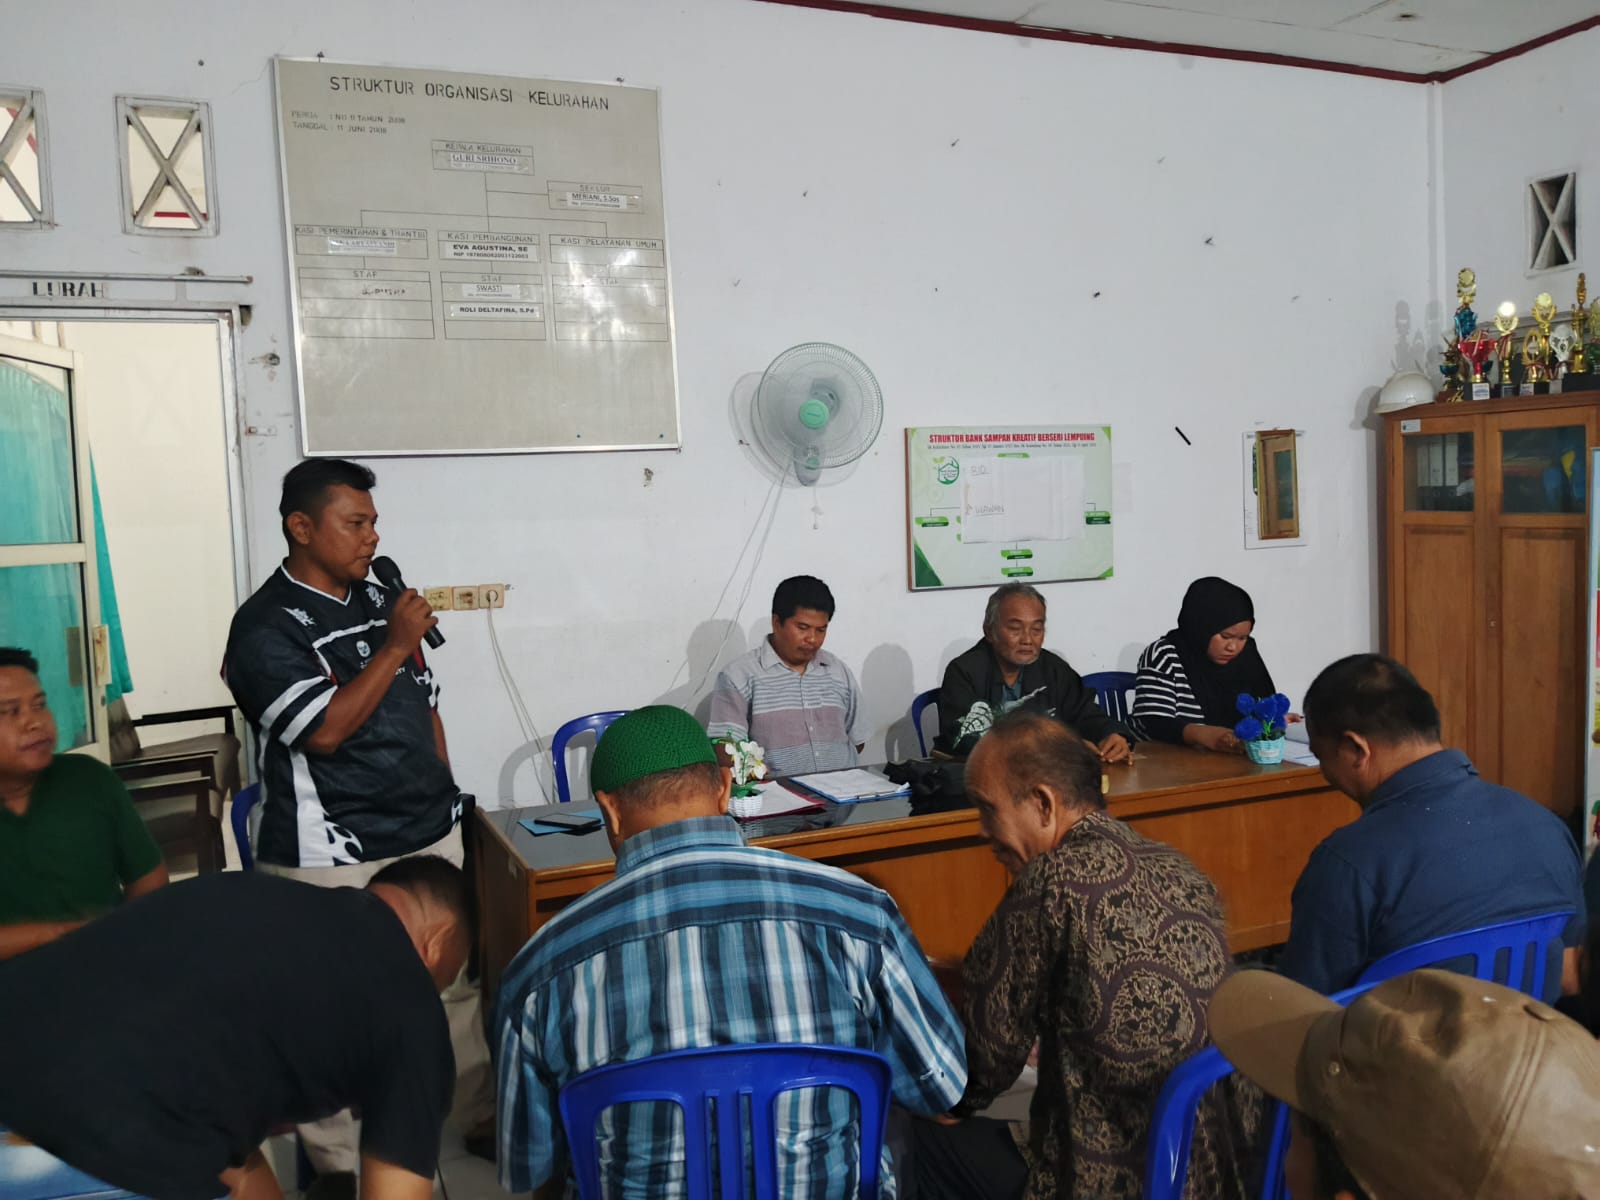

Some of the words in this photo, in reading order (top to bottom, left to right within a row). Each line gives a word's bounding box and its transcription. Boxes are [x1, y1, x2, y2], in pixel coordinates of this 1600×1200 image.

[330, 76, 415, 95] STRUKTUR
[425, 82, 513, 103] ORGANISASI
[528, 90, 609, 111] KELURAHAN
[477, 145, 521, 154] KELURAHAN
[447, 232, 469, 241] KASI
[473, 233, 533, 243] PEMBANGUNAN
[471, 244, 516, 252] AGUSTINA,
[586, 239, 631, 248] PELAYANAN
[353, 270, 377, 279] STAF
[32, 281, 104, 298] LURAH
[929, 434, 964, 443] STRUKTUR
[965, 434, 983, 442] BANK
[984, 433, 1011, 442] SAMPAH
[1012, 433, 1036, 441] KREATIF
